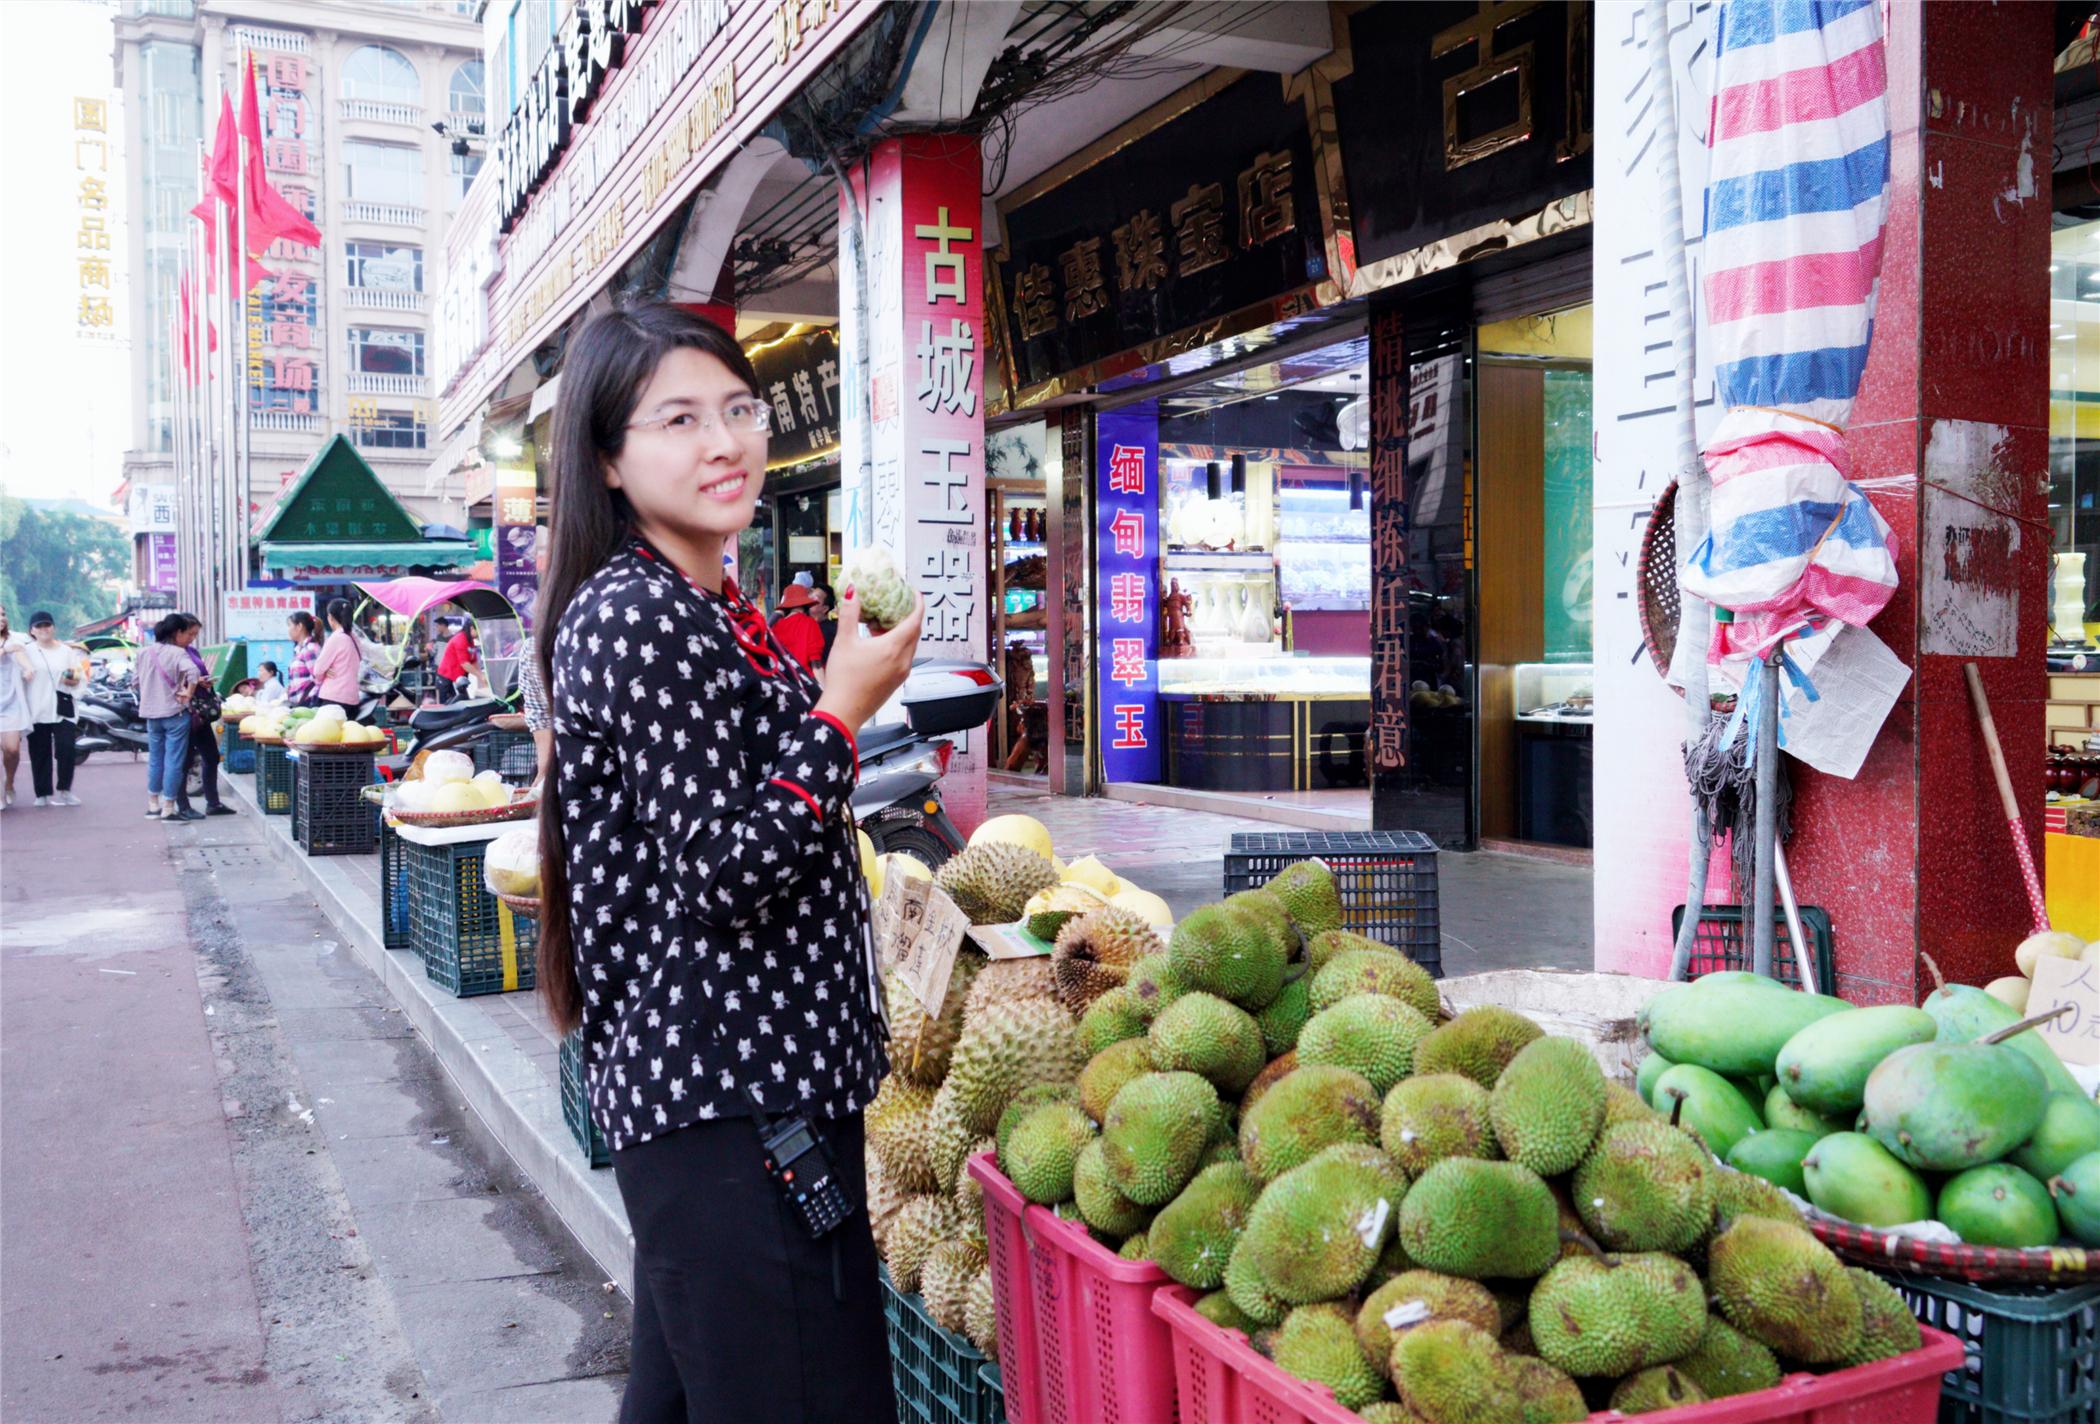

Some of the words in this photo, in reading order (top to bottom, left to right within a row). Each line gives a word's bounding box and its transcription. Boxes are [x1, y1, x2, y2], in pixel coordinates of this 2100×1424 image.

[1430, 0, 1594, 173] 古
[1013, 147, 1296, 341] 佳惠珠宝店
[765, 360, 840, 438] 南特产
[1109, 443, 1148, 749] 缅甸翡翠玉
[1371, 312, 1406, 770] 精挑细拣任君意
